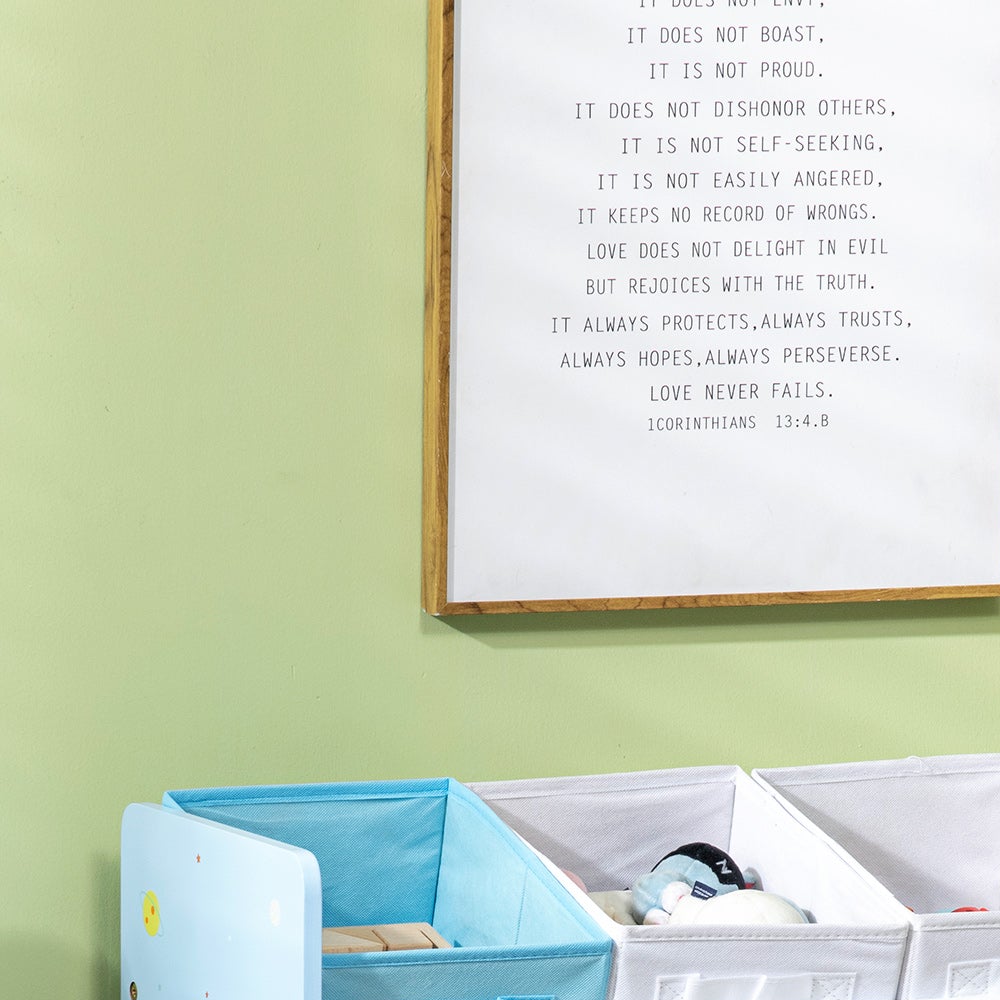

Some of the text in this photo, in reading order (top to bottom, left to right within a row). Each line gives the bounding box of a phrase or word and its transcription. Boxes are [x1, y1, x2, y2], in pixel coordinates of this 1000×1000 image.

[628, 25, 825, 44] IT DOES NOT BOAST,
[650, 61, 825, 79] IT IS NOT PROUD.
[576, 98, 897, 119] IT DOES NOT DISHONOR OTHERS,
[622, 134, 885, 155] IT IS NOT SELF-SEEKING,
[599, 170, 884, 190] IT IS NOT EASILY ANGERED,
[578, 203, 878, 224] IT KEEPS NO RECORD OF WRONGS.
[588, 238, 889, 260] LOVE DOES NOT DELIGHT IN EVIL
[587, 274, 876, 296] BUT REJOICES WITH THE TRUTH.
[552, 310, 913, 334] IT ALWAYS PROTECTS,ALWAYS TRUSTS,
[560, 345, 901, 368] ALWAYS HOPES,ALWAYS PERSEVERSE.
[650, 382, 834, 402] LOVE NEVER FAILS.
[648, 414, 830, 432] 1CORINTHIANS 13:4.B
